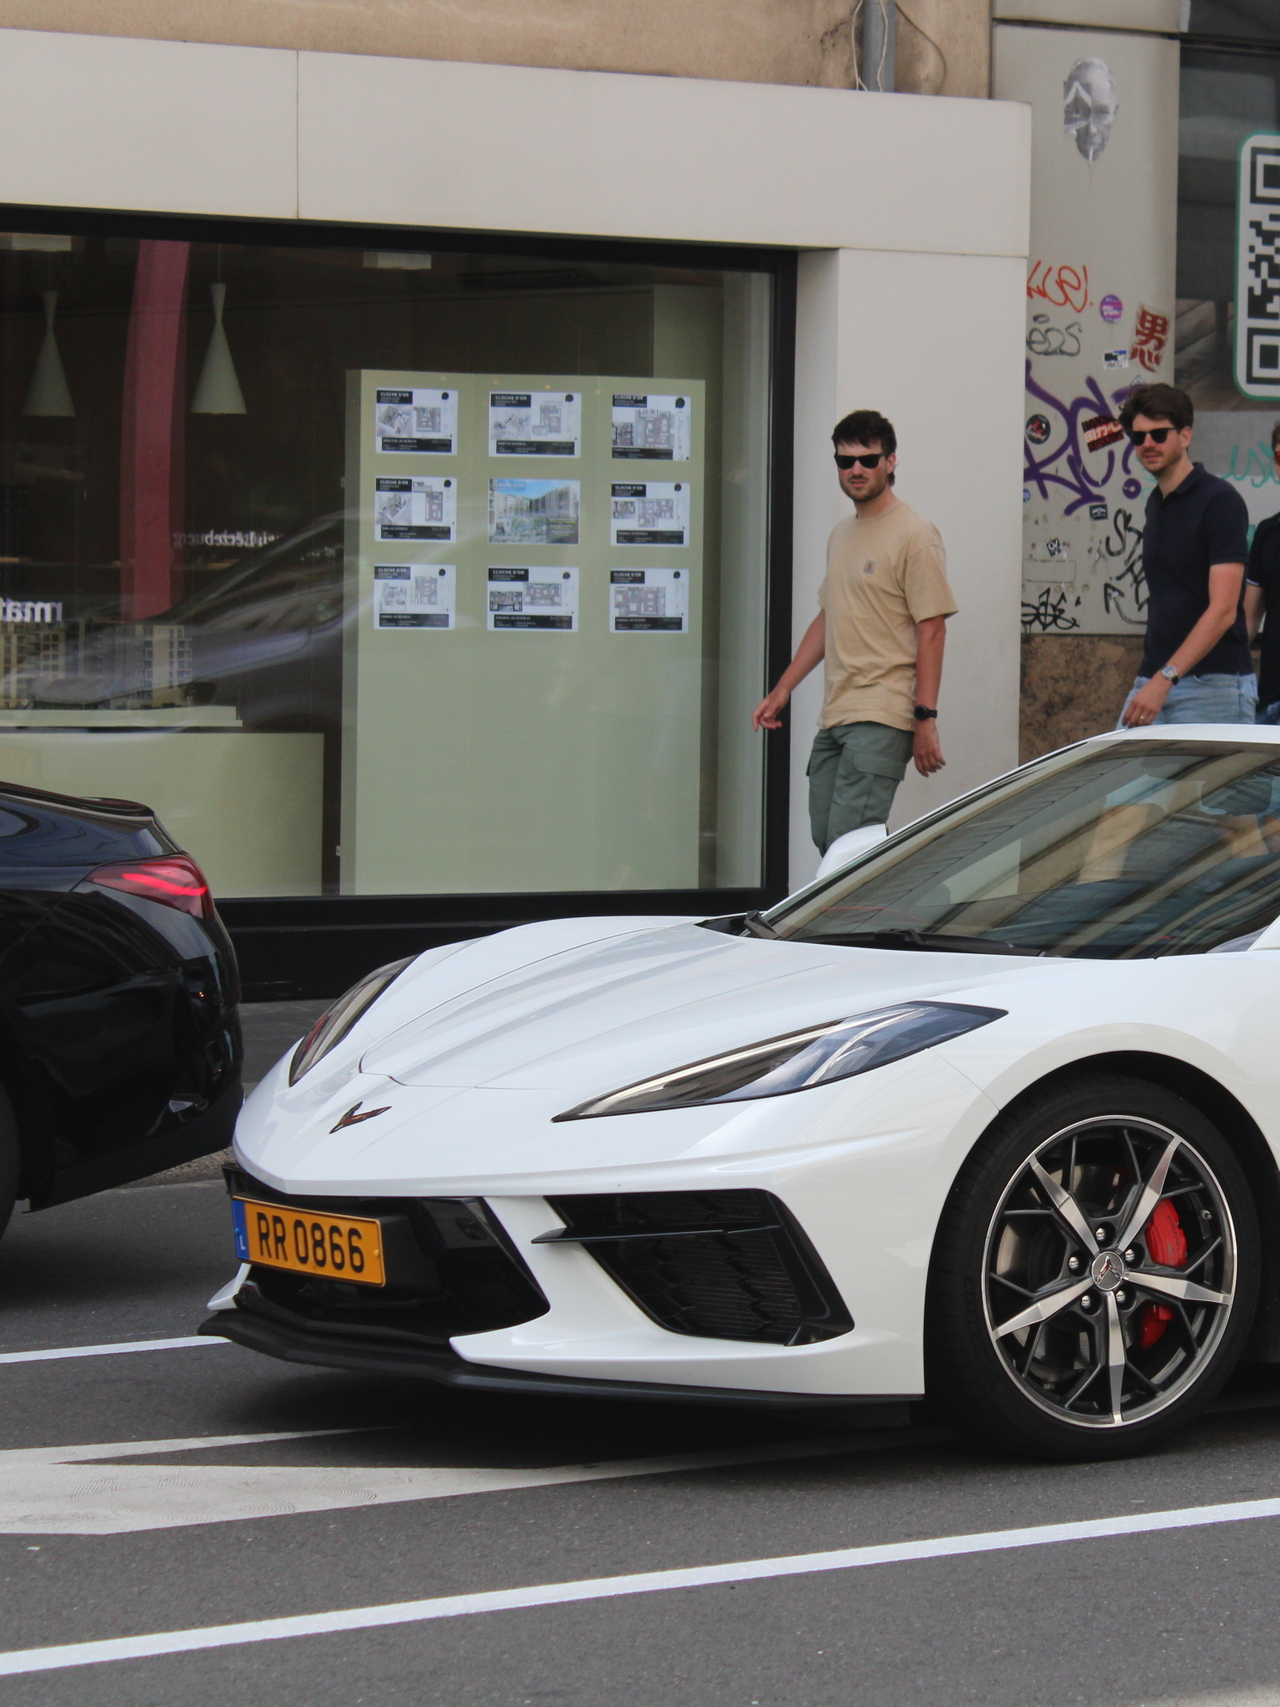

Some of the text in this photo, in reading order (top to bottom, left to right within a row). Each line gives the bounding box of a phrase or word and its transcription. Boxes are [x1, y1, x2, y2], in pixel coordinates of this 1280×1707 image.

[239, 1212, 365, 1273] L RR 0866
